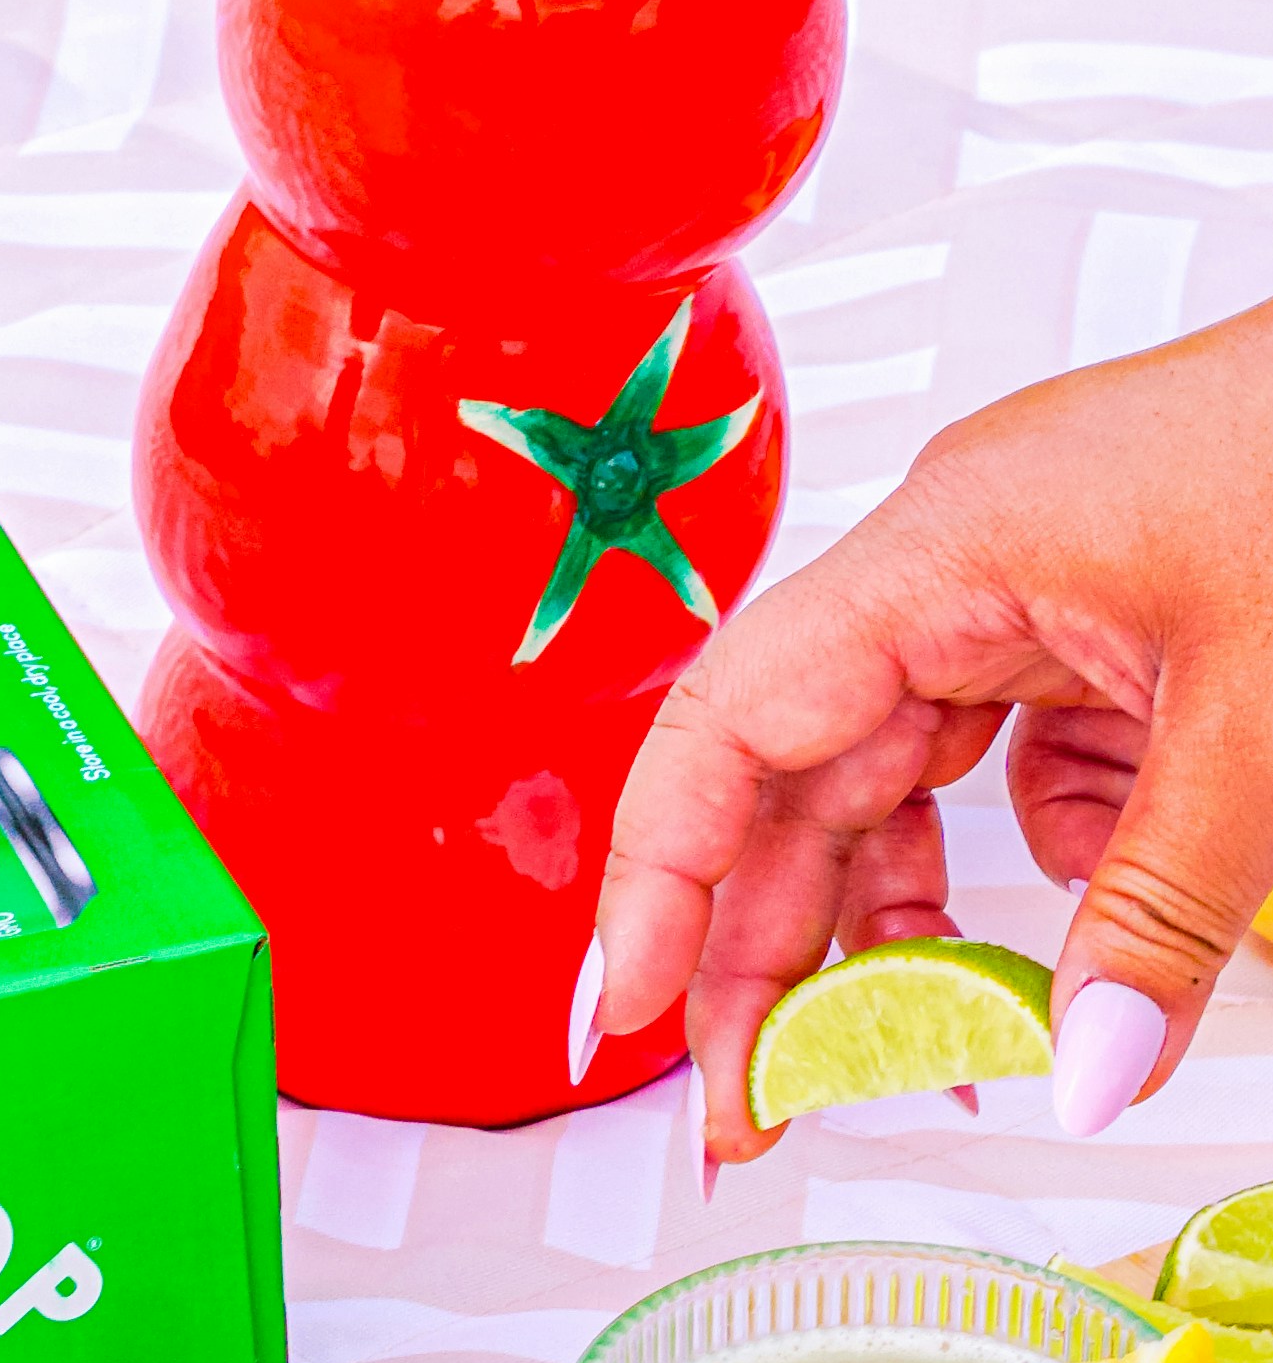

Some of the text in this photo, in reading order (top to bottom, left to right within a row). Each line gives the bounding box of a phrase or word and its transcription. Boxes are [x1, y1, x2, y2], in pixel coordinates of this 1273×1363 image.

[21, 664, 50, 685] dry
[59, 719, 78, 730] a
[62, 730, 87, 745] in
[76, 744, 111, 781] Store
